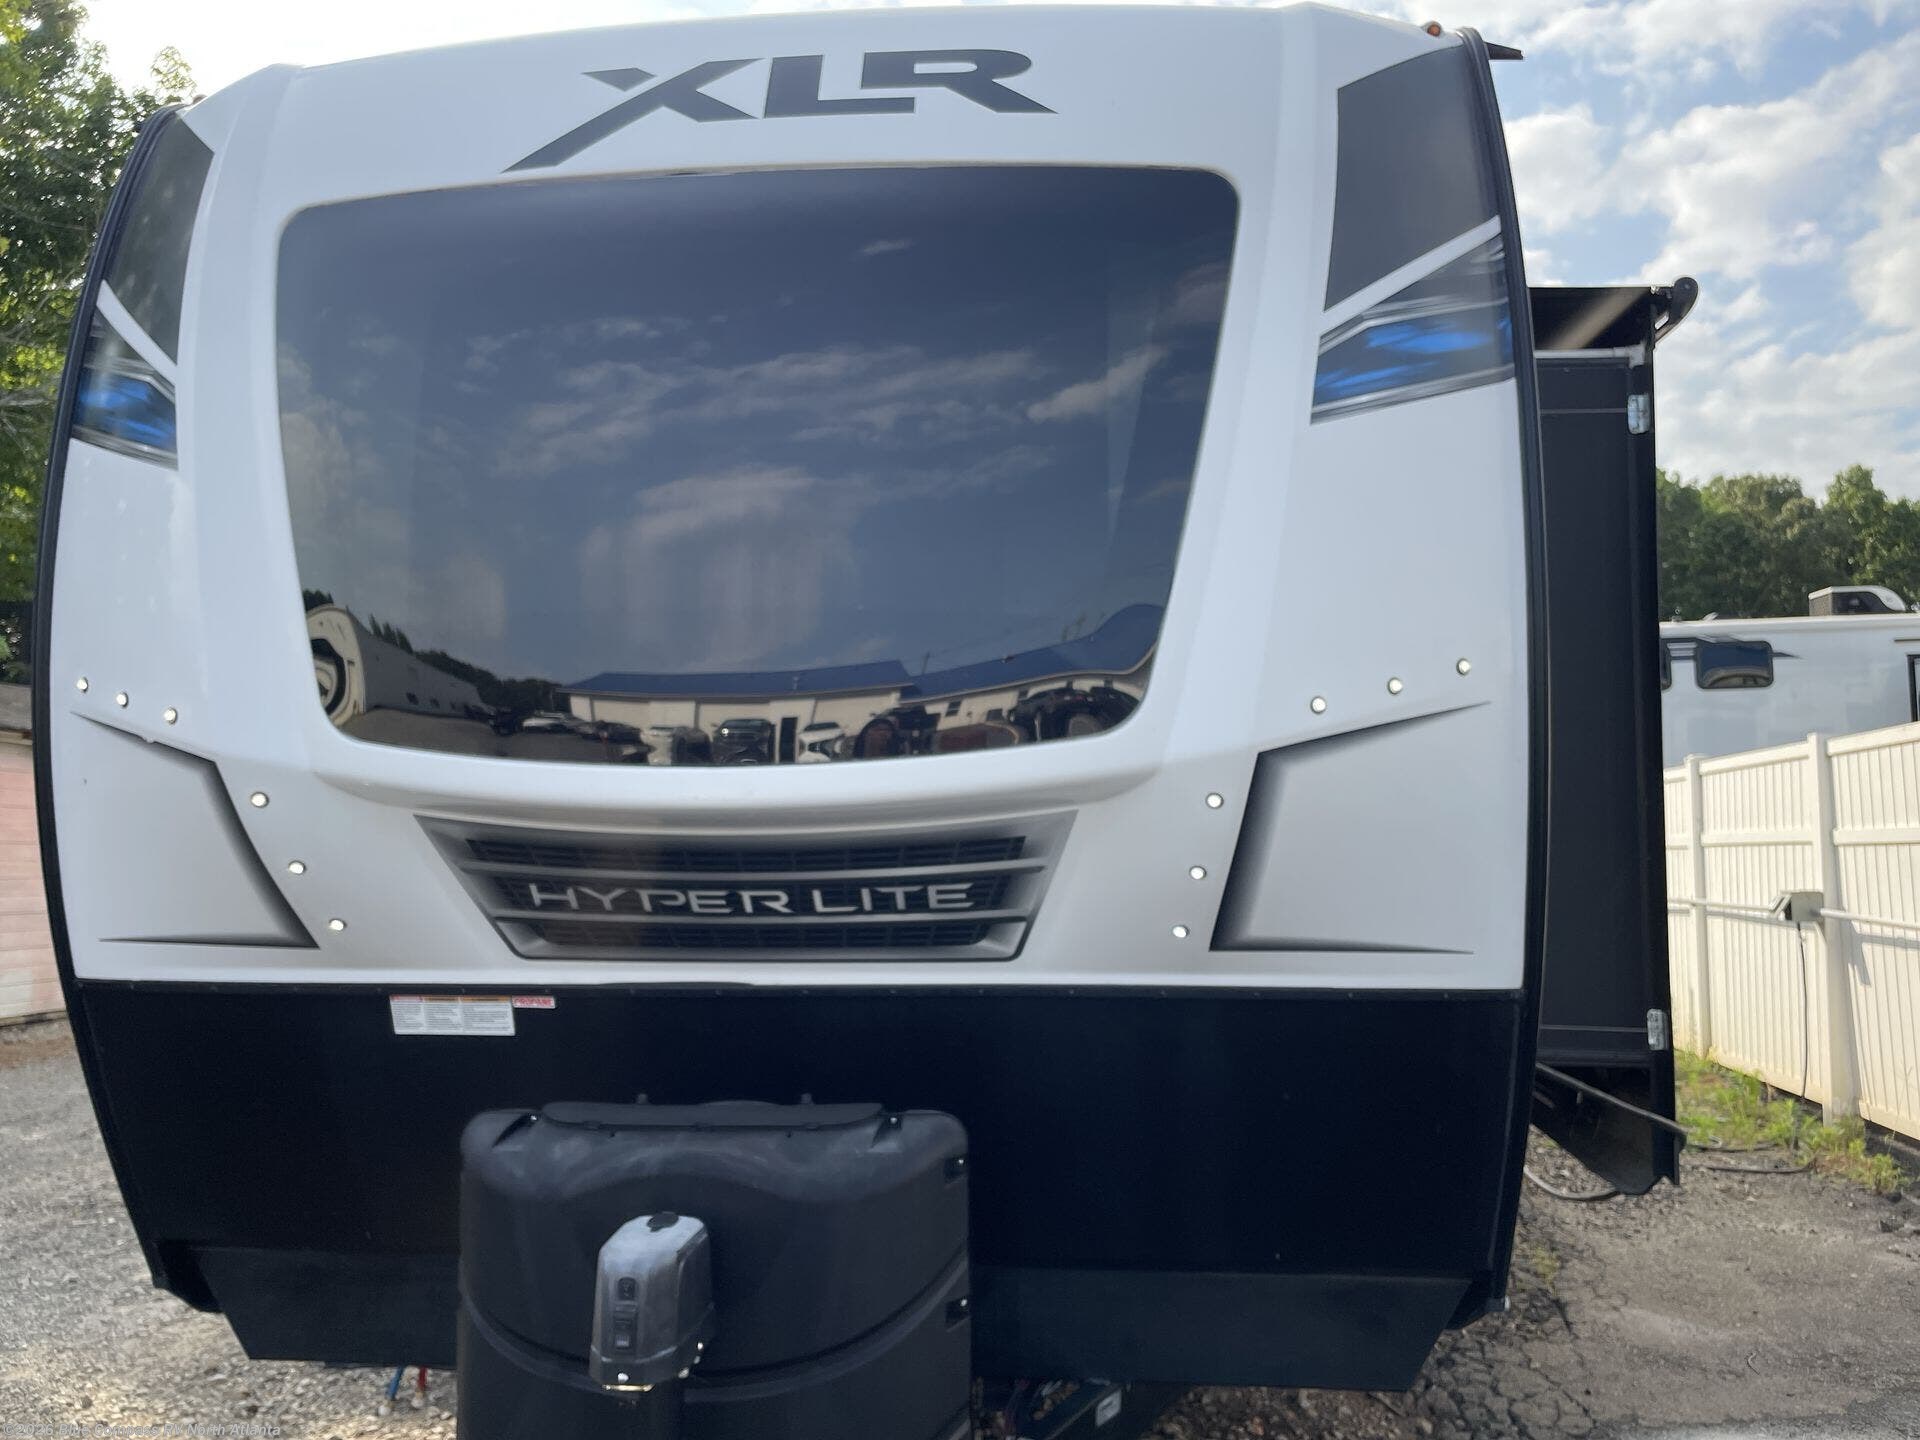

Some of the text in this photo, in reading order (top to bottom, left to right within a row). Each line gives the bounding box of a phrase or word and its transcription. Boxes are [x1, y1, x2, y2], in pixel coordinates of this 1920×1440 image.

[501, 49, 1058, 173] XLR
[527, 881, 975, 915] HYPER LITE
